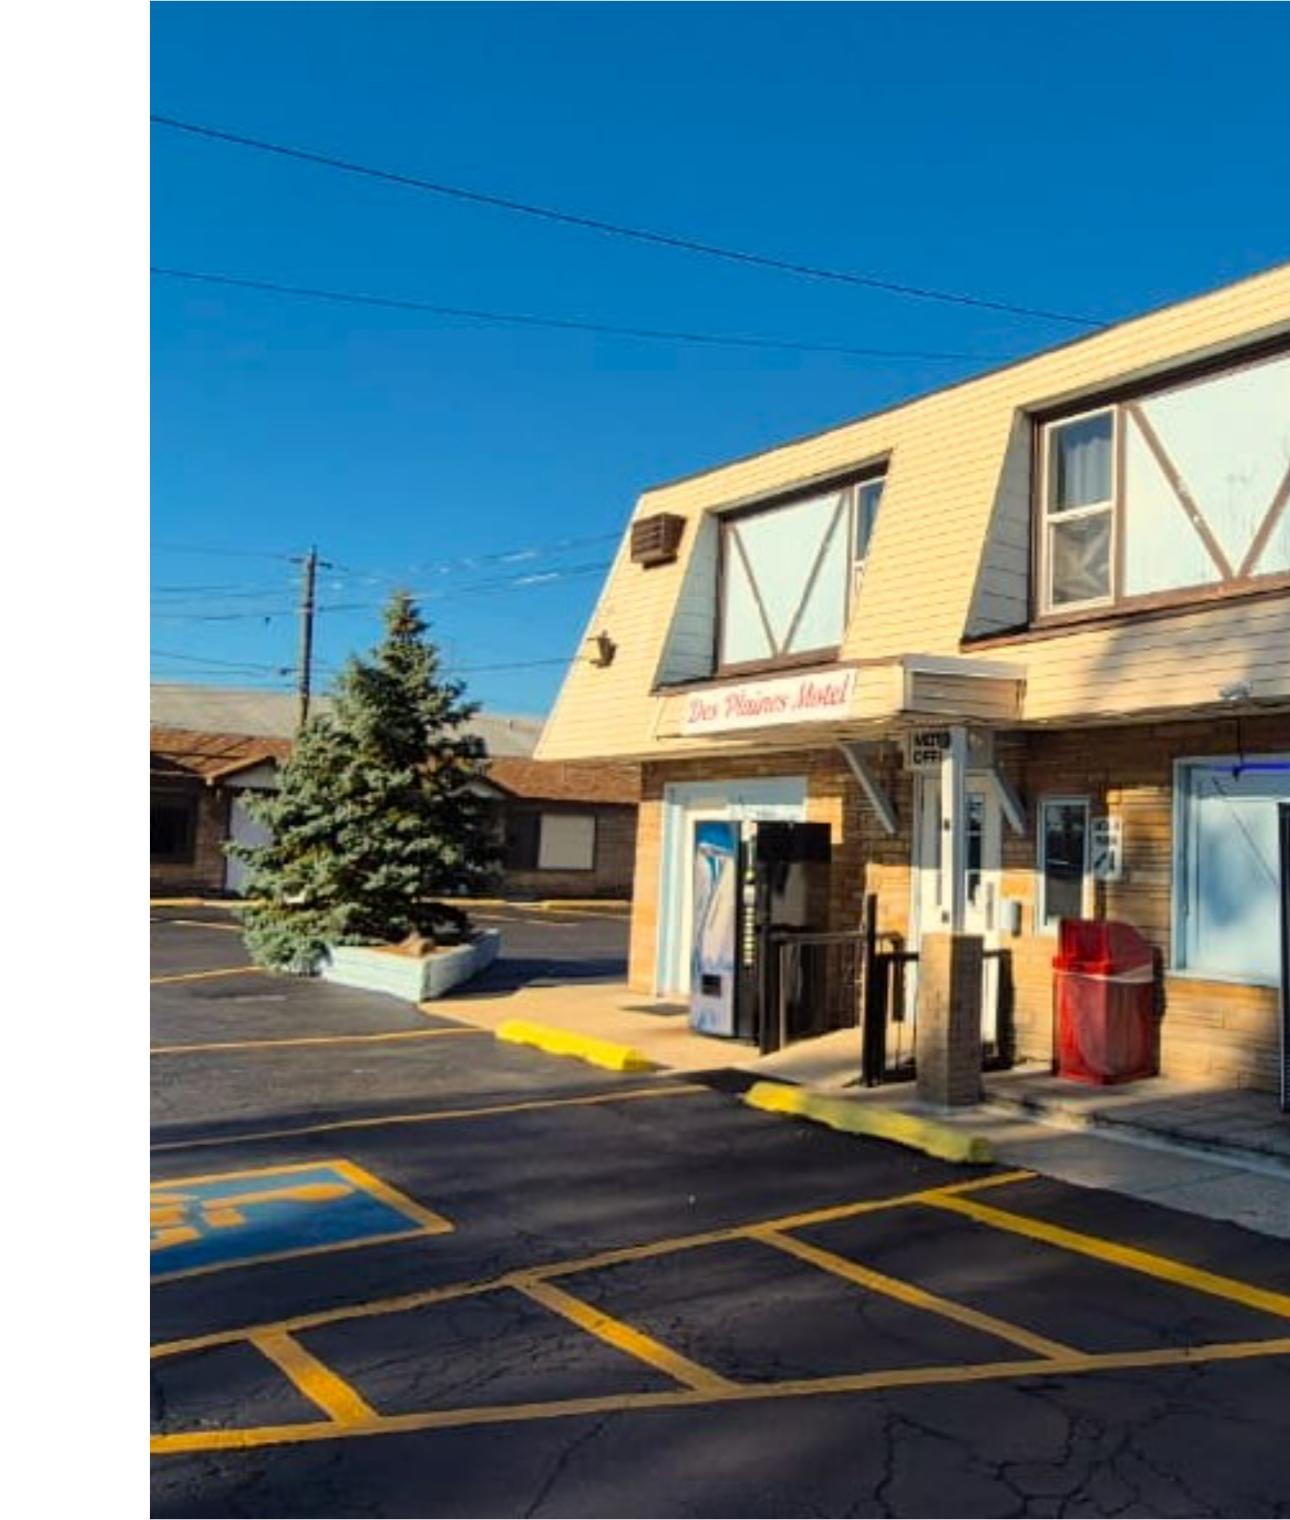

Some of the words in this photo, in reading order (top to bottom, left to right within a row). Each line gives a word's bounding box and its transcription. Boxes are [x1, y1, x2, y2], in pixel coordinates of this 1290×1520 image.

[688, 697, 717, 723] Des
[726, 689, 788, 718] Plaines
[791, 673, 850, 708] Motel
